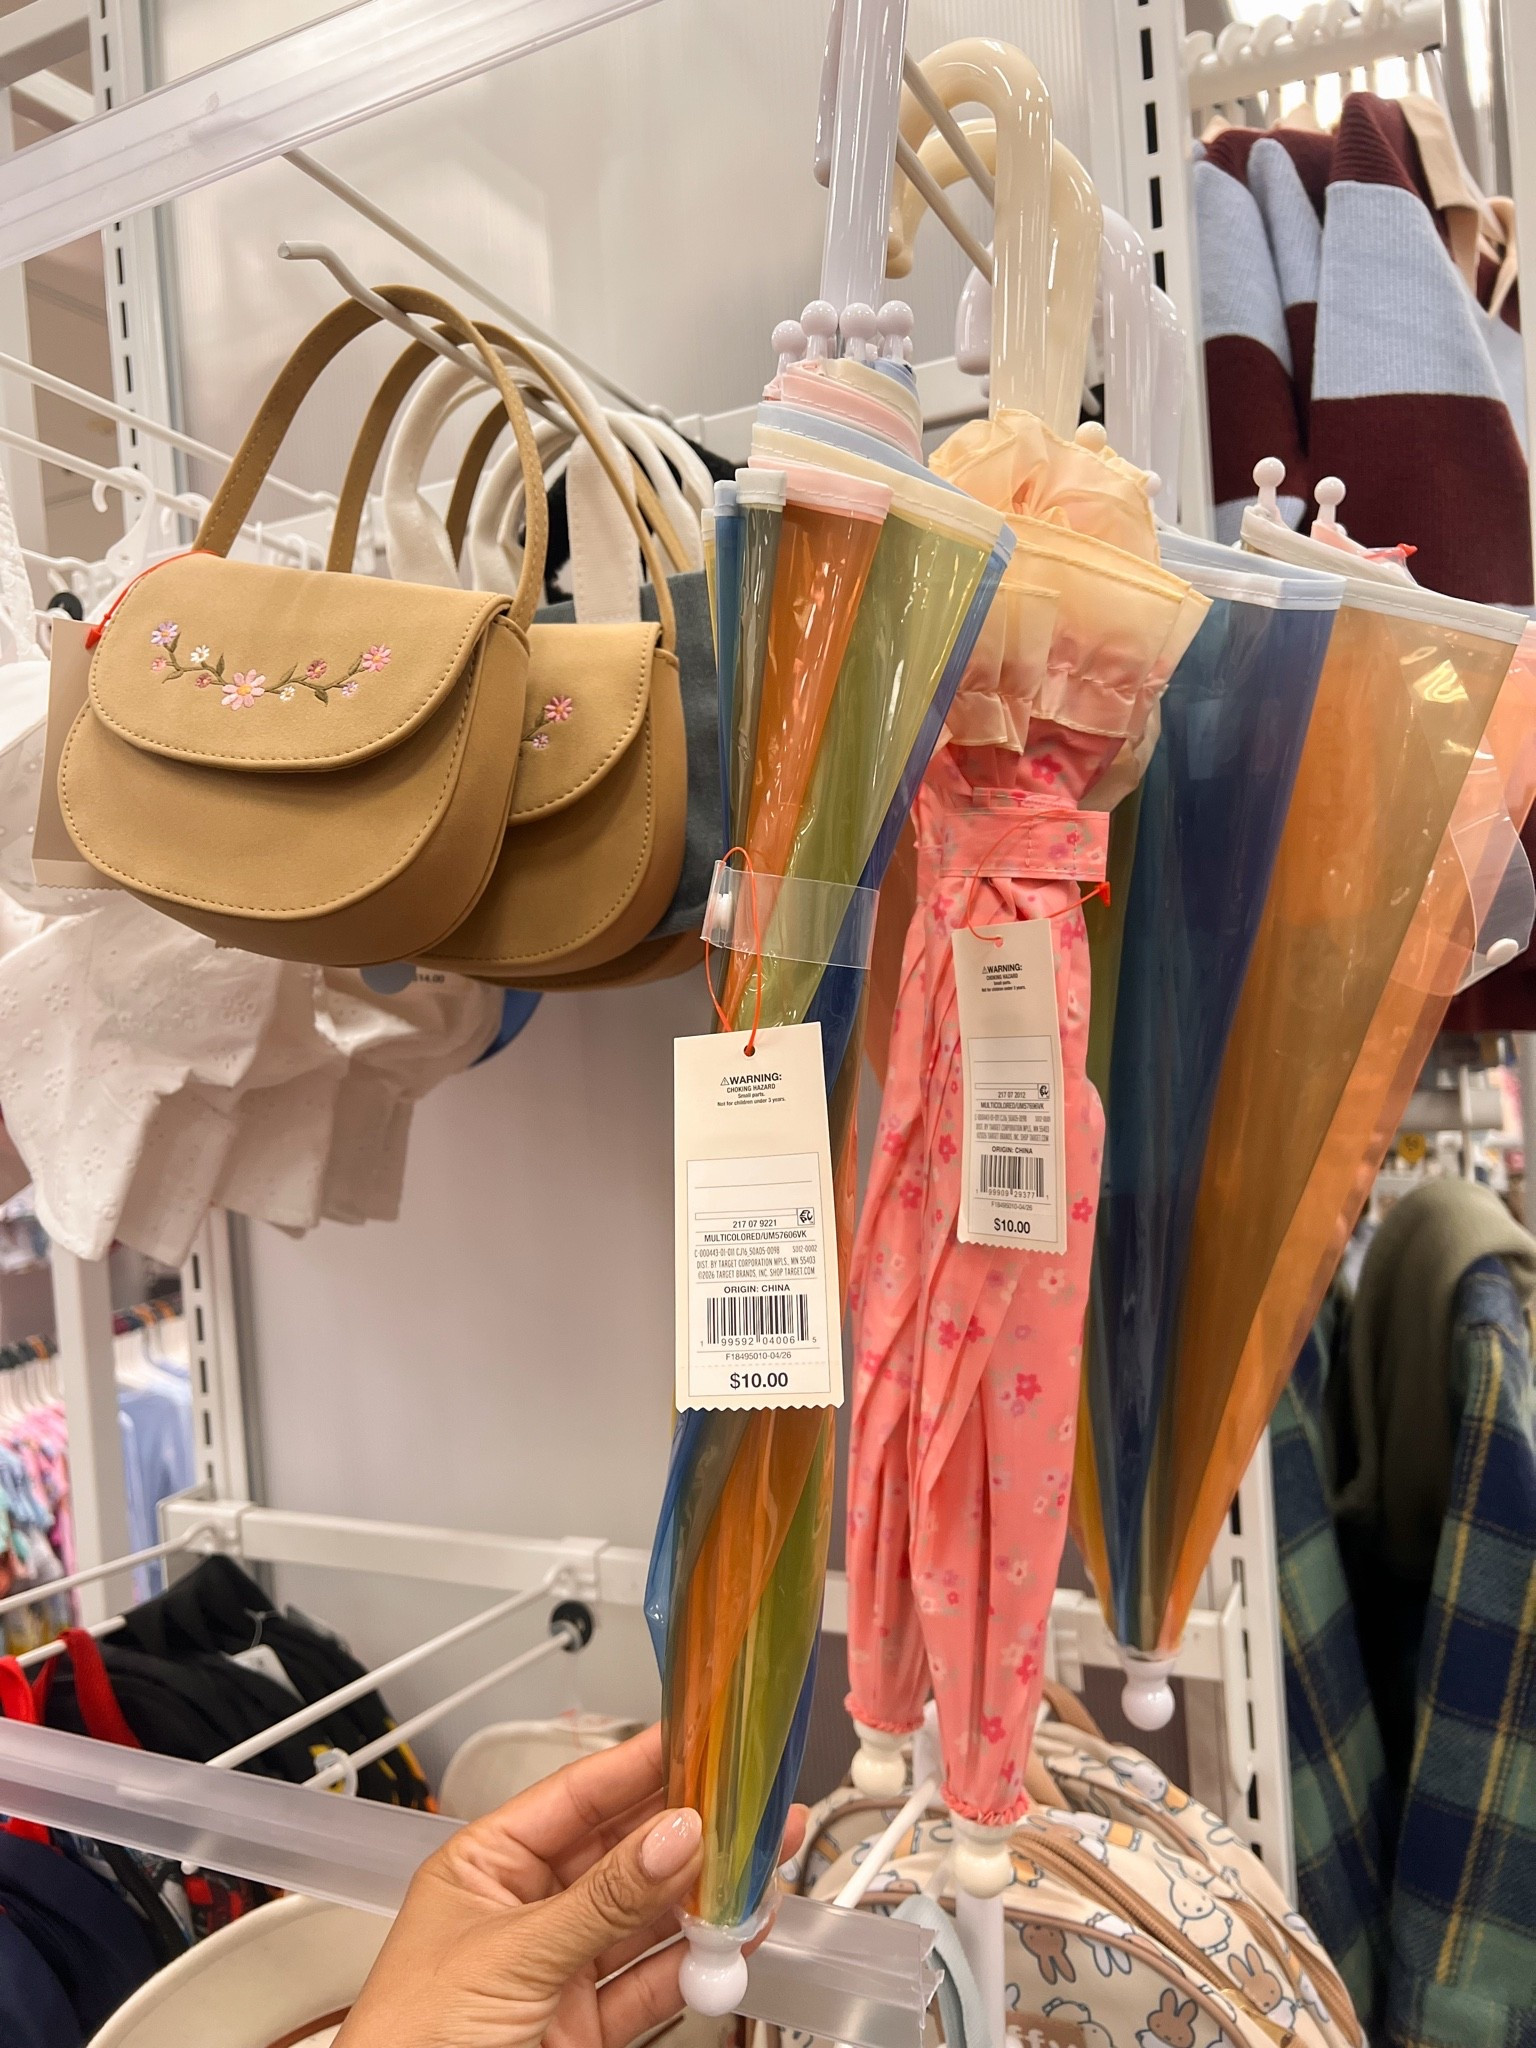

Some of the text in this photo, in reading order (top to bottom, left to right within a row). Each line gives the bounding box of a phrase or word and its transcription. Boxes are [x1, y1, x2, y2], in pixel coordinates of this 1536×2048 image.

[987, 964, 1022, 973] WARNING:
[730, 1072, 782, 1084] WARNING:
[726, 1085, 752, 1093] CHOKING
[1014, 1191, 1035, 1199] 29377
[760, 1219, 777, 1227] 9221
[994, 1218, 1031, 1234] $10.00
[704, 1230, 807, 1242] MULTICOLORED/UM57606VK
[710, 1260, 717, 1269] BY
[718, 1259, 737, 1268] TARGET
[738, 1258, 773, 1268] CORPORATION
[800, 1256, 816, 1264] 55403
[716, 1270, 735, 1279] TARGET
[736, 1269, 757, 1279] BRANDS,
[770, 1268, 784, 1277] SHOP
[784, 1266, 815, 1276] TARGET.COM
[724, 1284, 791, 1294] ORIGIN: CHINA
[721, 1338, 754, 1346] 99592
[762, 1336, 795, 1344] 04006
[725, 1352, 792, 1360] F18495010-04/26
[730, 1372, 788, 1390] $10.00
